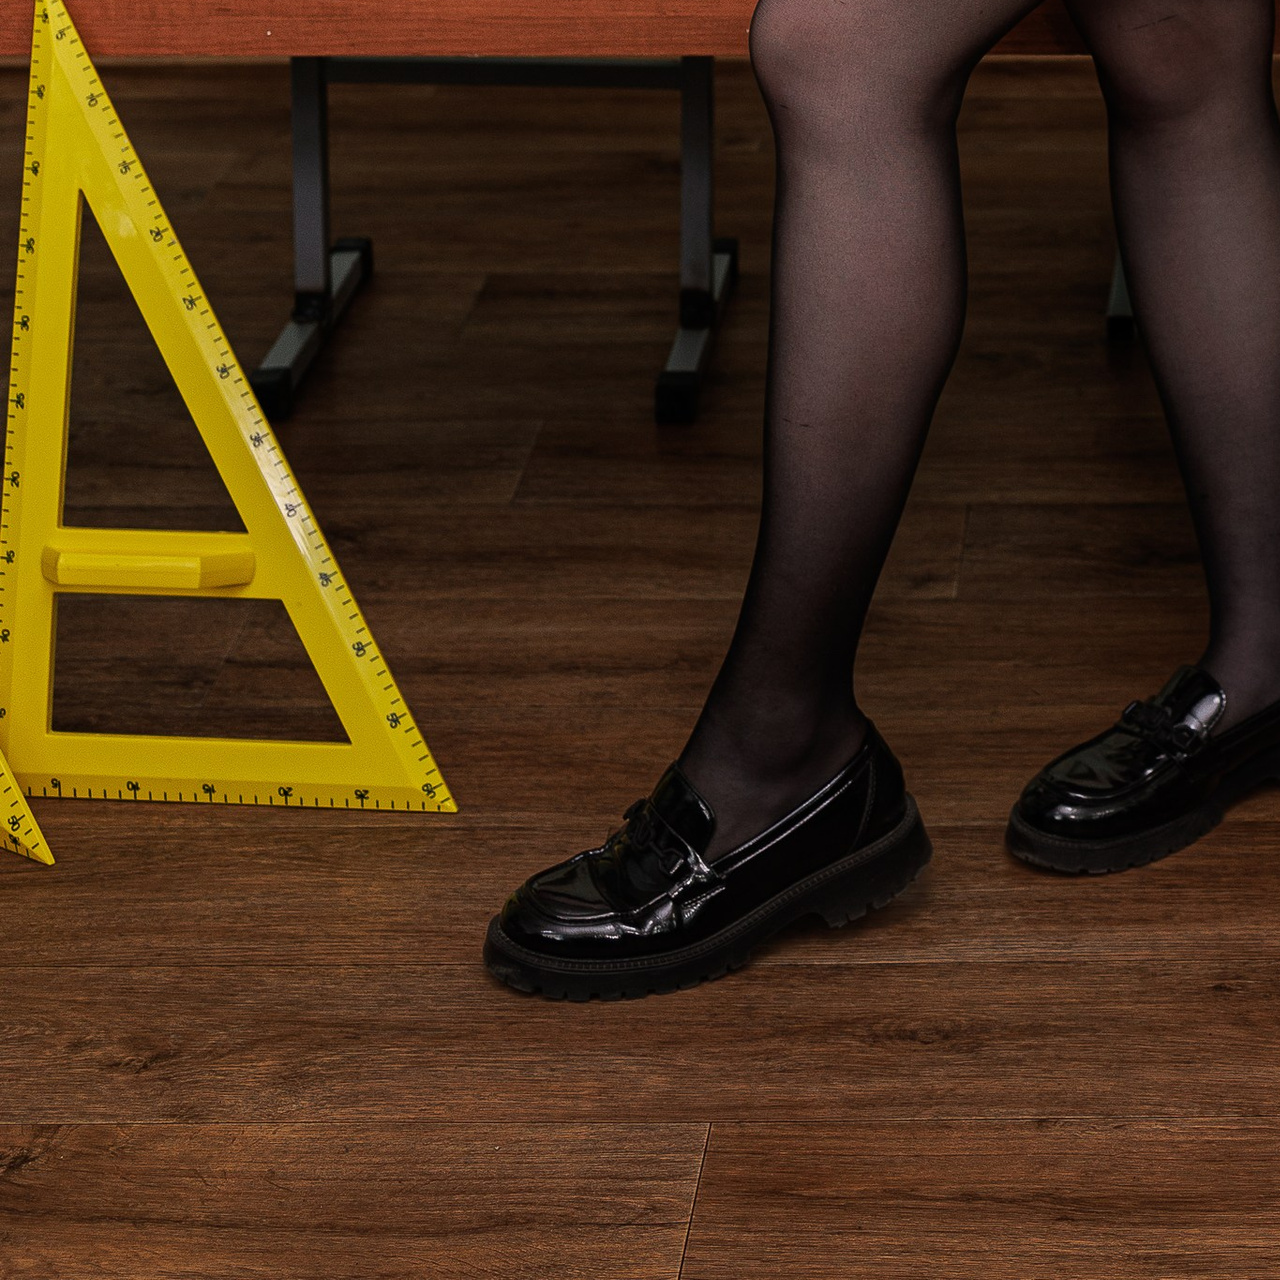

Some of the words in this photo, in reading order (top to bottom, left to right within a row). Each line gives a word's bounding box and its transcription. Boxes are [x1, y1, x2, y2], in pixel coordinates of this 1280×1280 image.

[150, 227, 164, 243] 20
[182, 294, 197, 311] 25
[216, 363, 230, 380] 30
[318, 571, 333, 588] 45
[352, 640, 367, 658] 50
[386, 711, 401, 729] 55
[421, 783, 438, 800] 60
